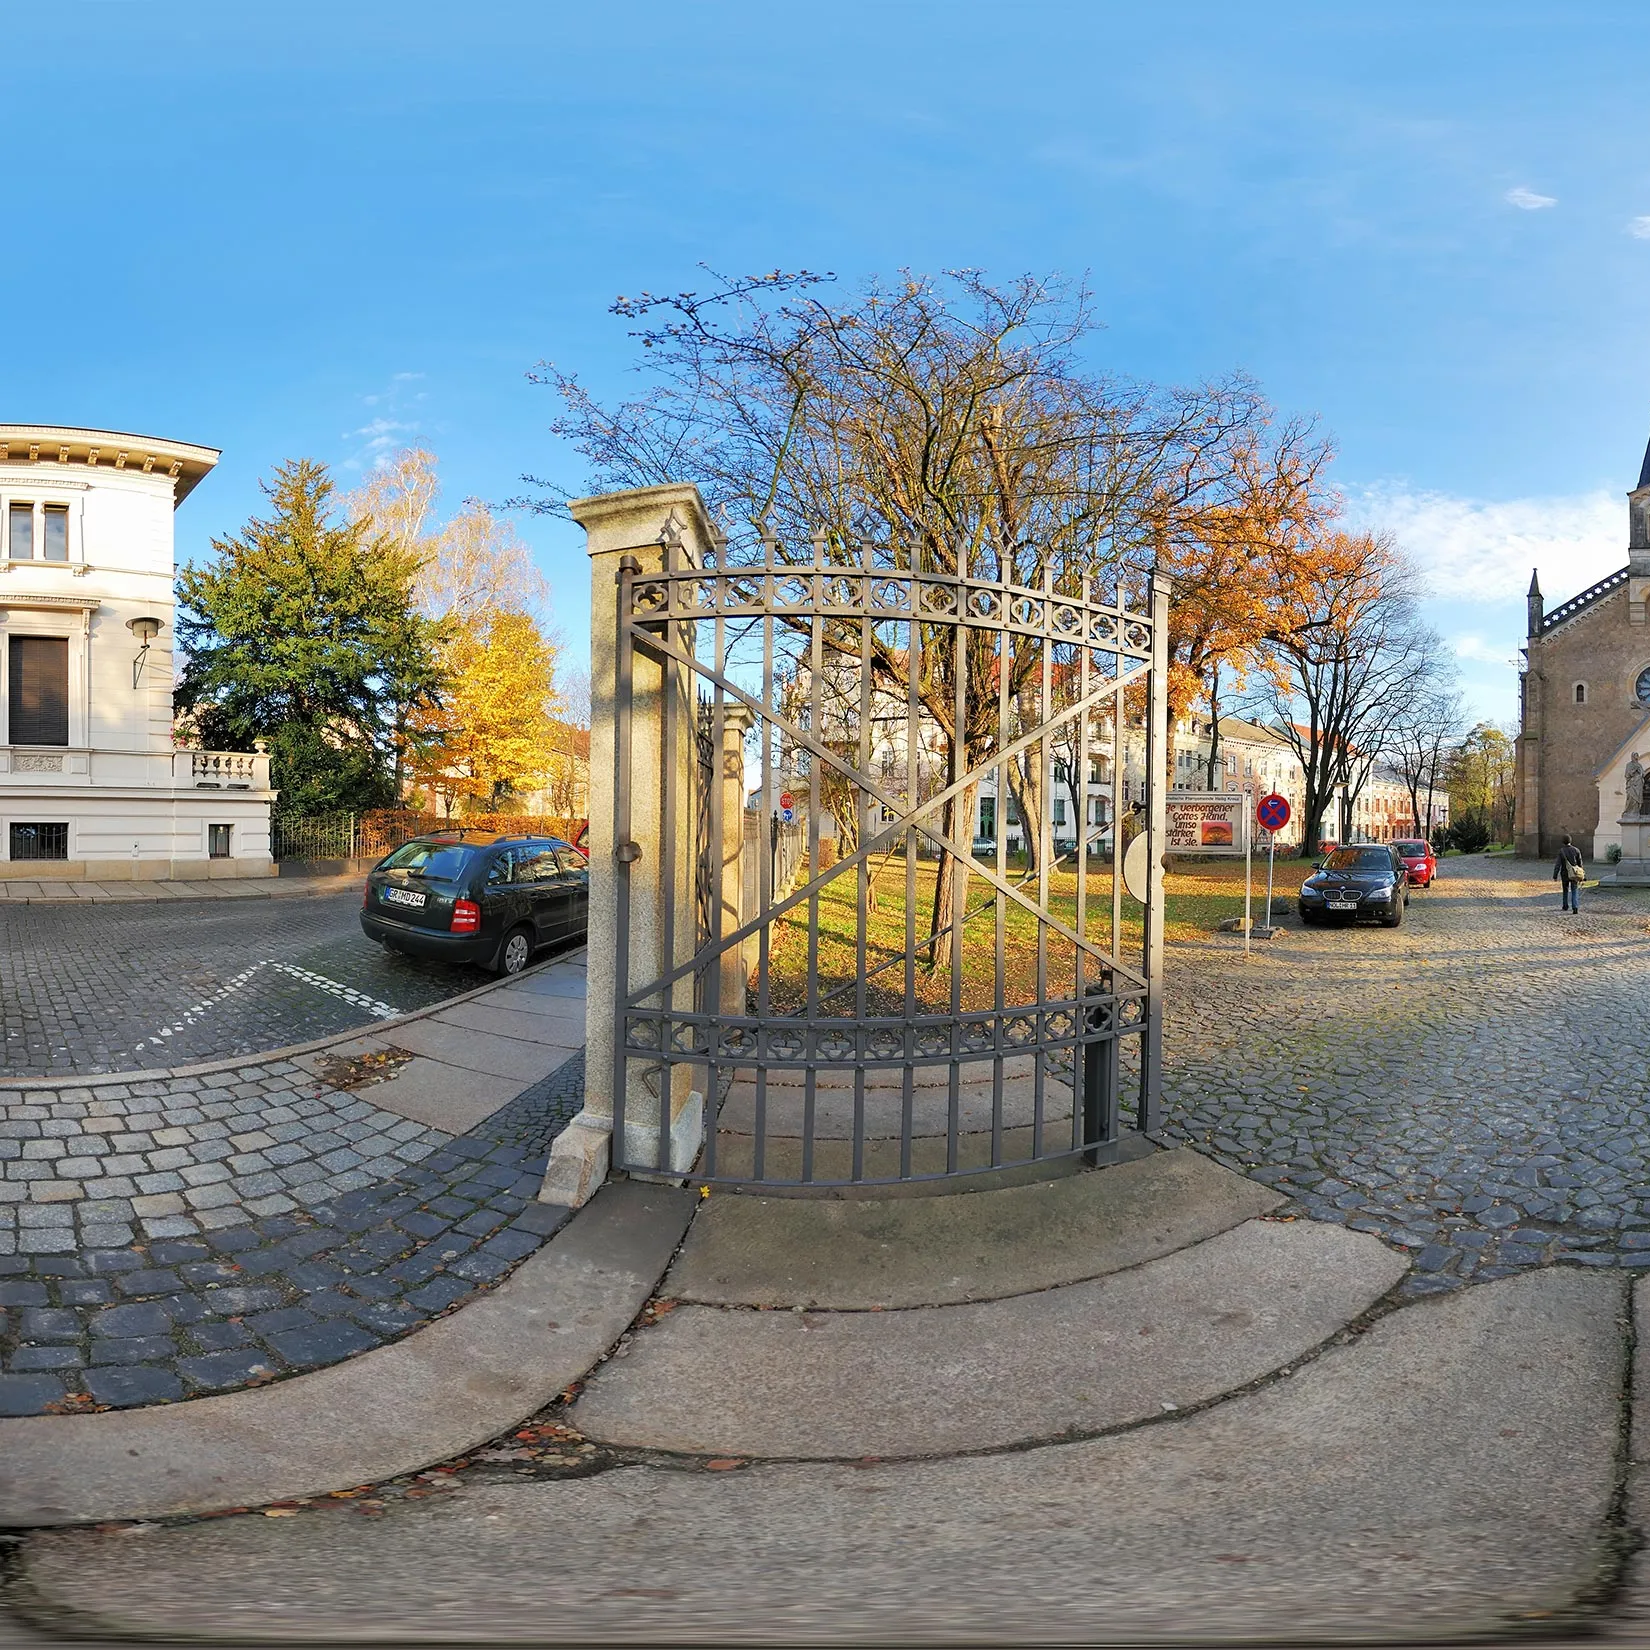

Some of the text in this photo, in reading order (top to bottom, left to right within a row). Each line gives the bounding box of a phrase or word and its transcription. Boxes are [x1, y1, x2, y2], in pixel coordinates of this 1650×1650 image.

[1180, 803, 1234, 813] verborgener
[1172, 812, 1199, 822] Gottes
[1175, 821, 1197, 829] umso
[1166, 830, 1195, 838] stärker
[1171, 837, 1198, 846] ist sie.
